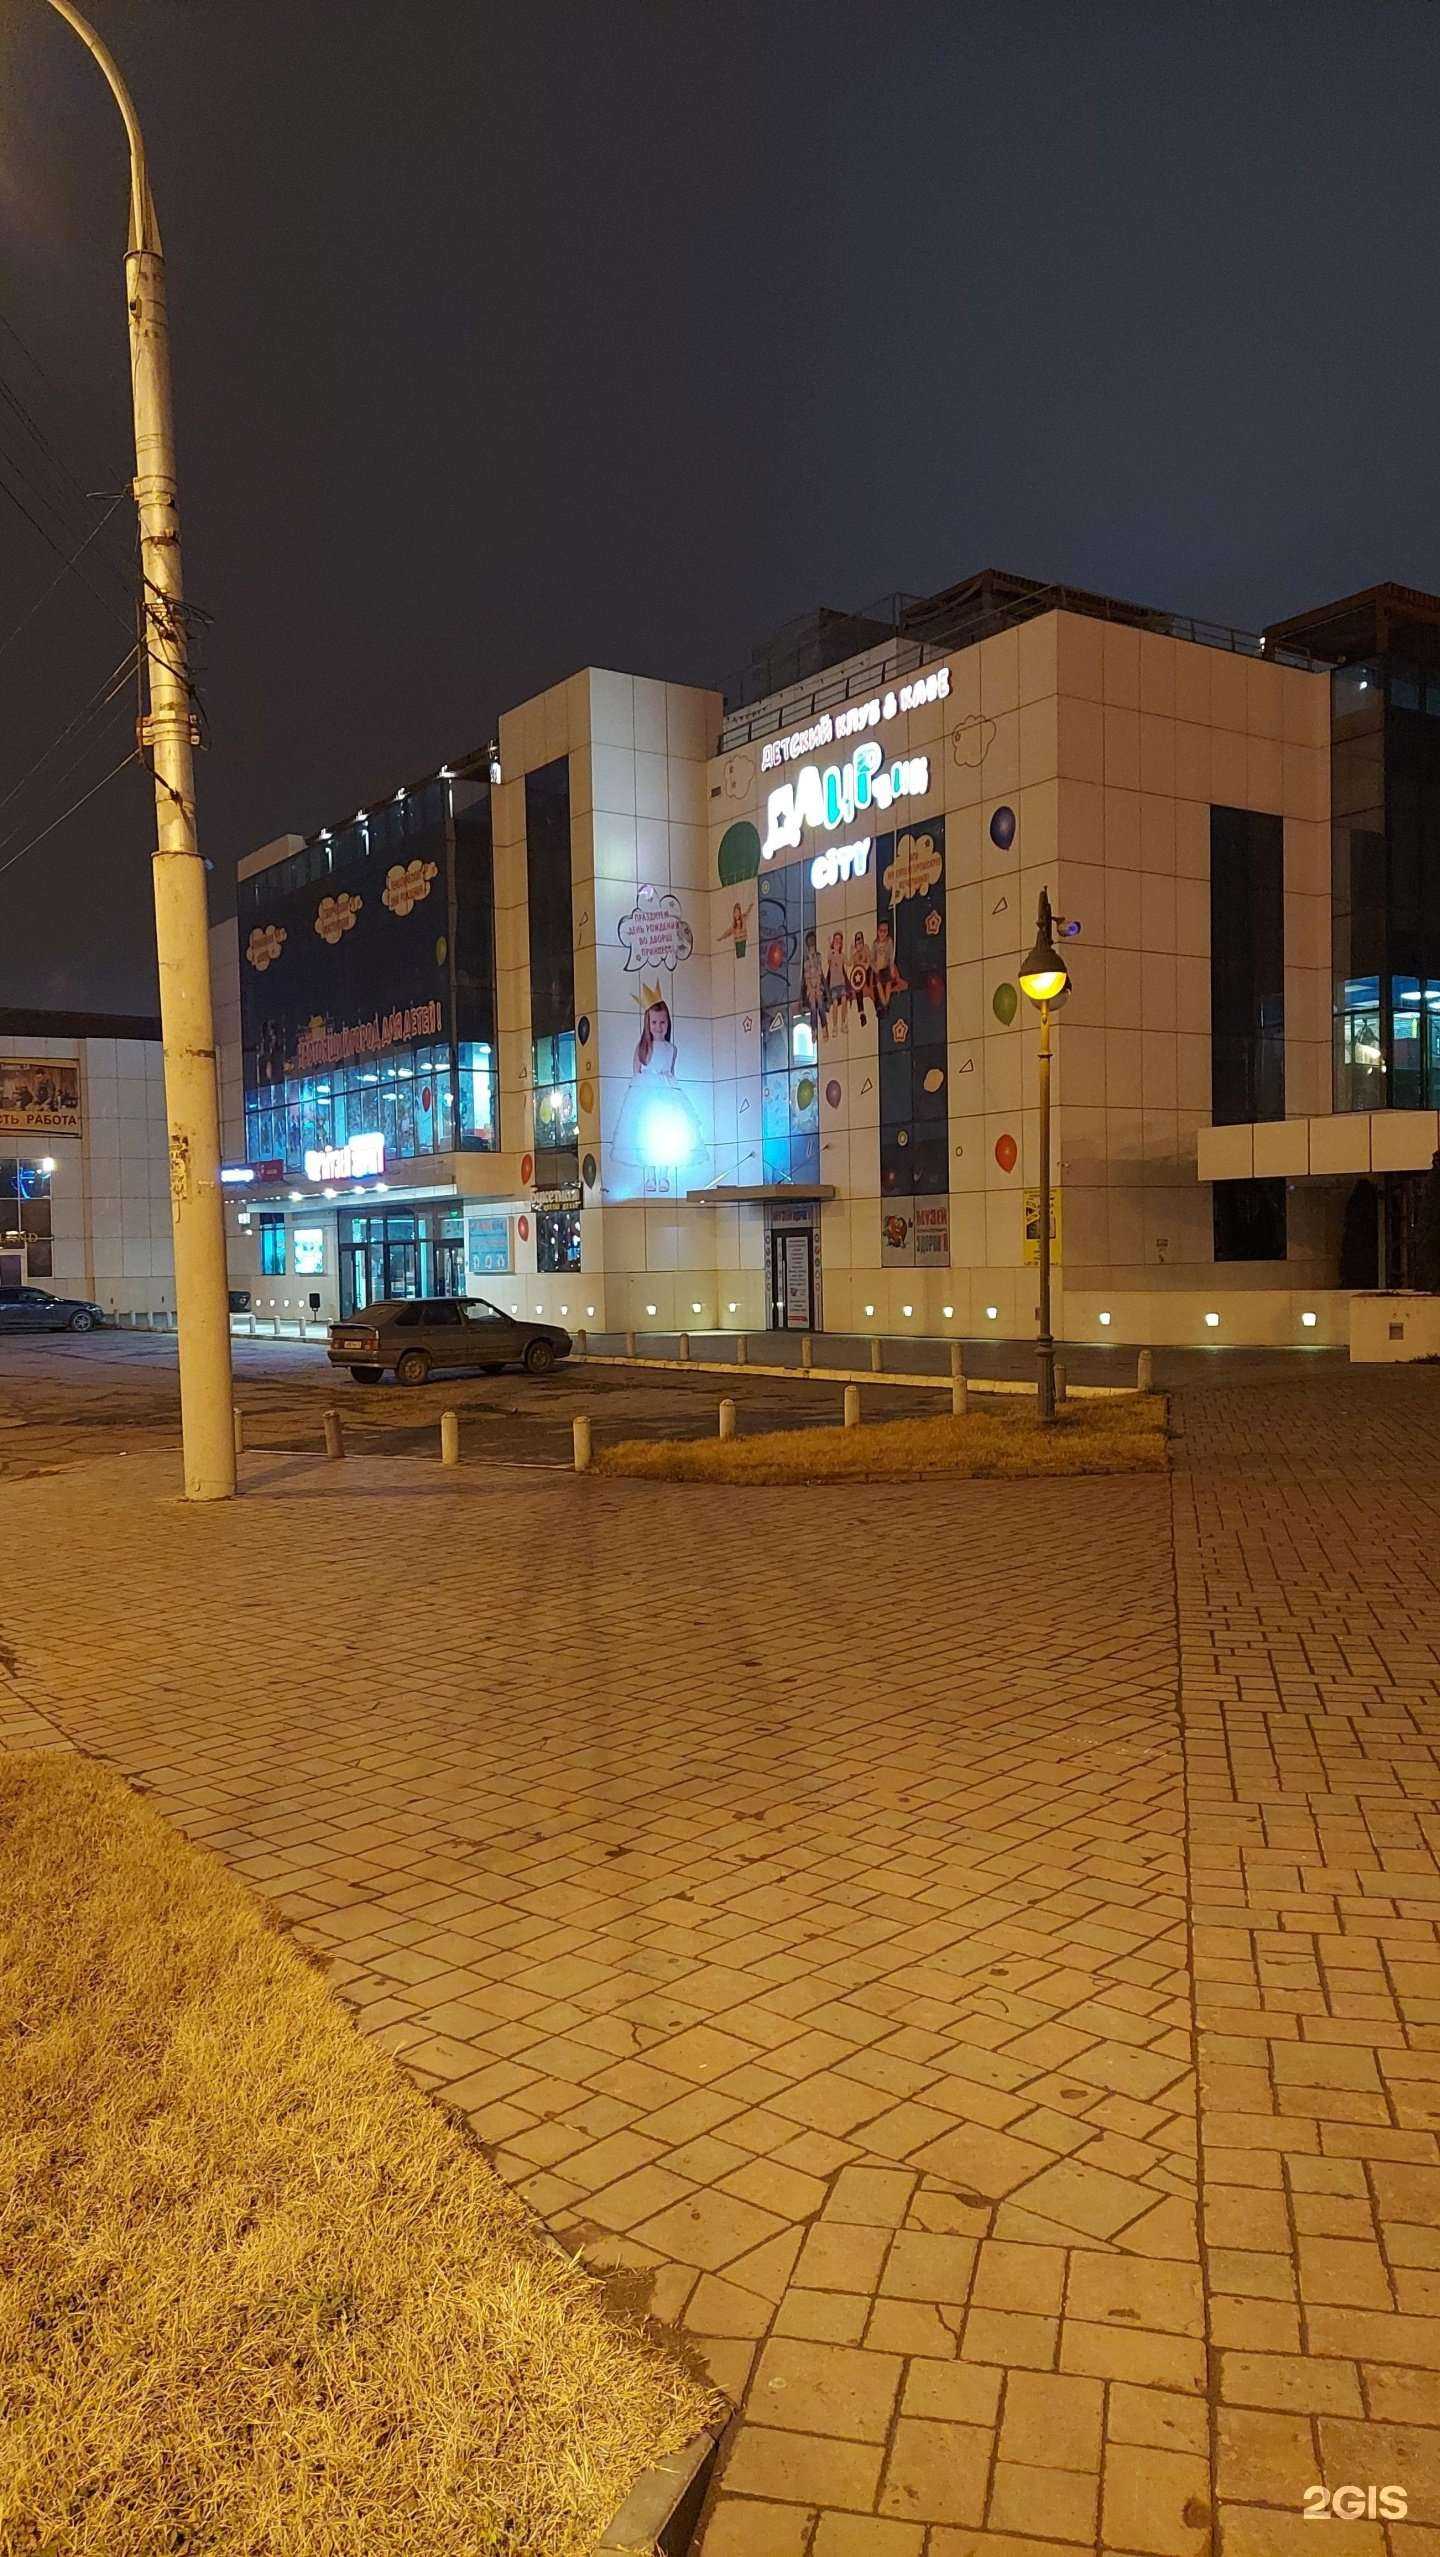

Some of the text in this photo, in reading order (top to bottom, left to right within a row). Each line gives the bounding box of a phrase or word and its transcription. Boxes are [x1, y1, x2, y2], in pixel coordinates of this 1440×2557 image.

[762, 713, 833, 772] ДЕТСКИЙ
[834, 698, 881, 739] КЛУБ
[899, 667, 950, 712] КАФЕ
[26, 1113, 77, 1126] РАБОТА
